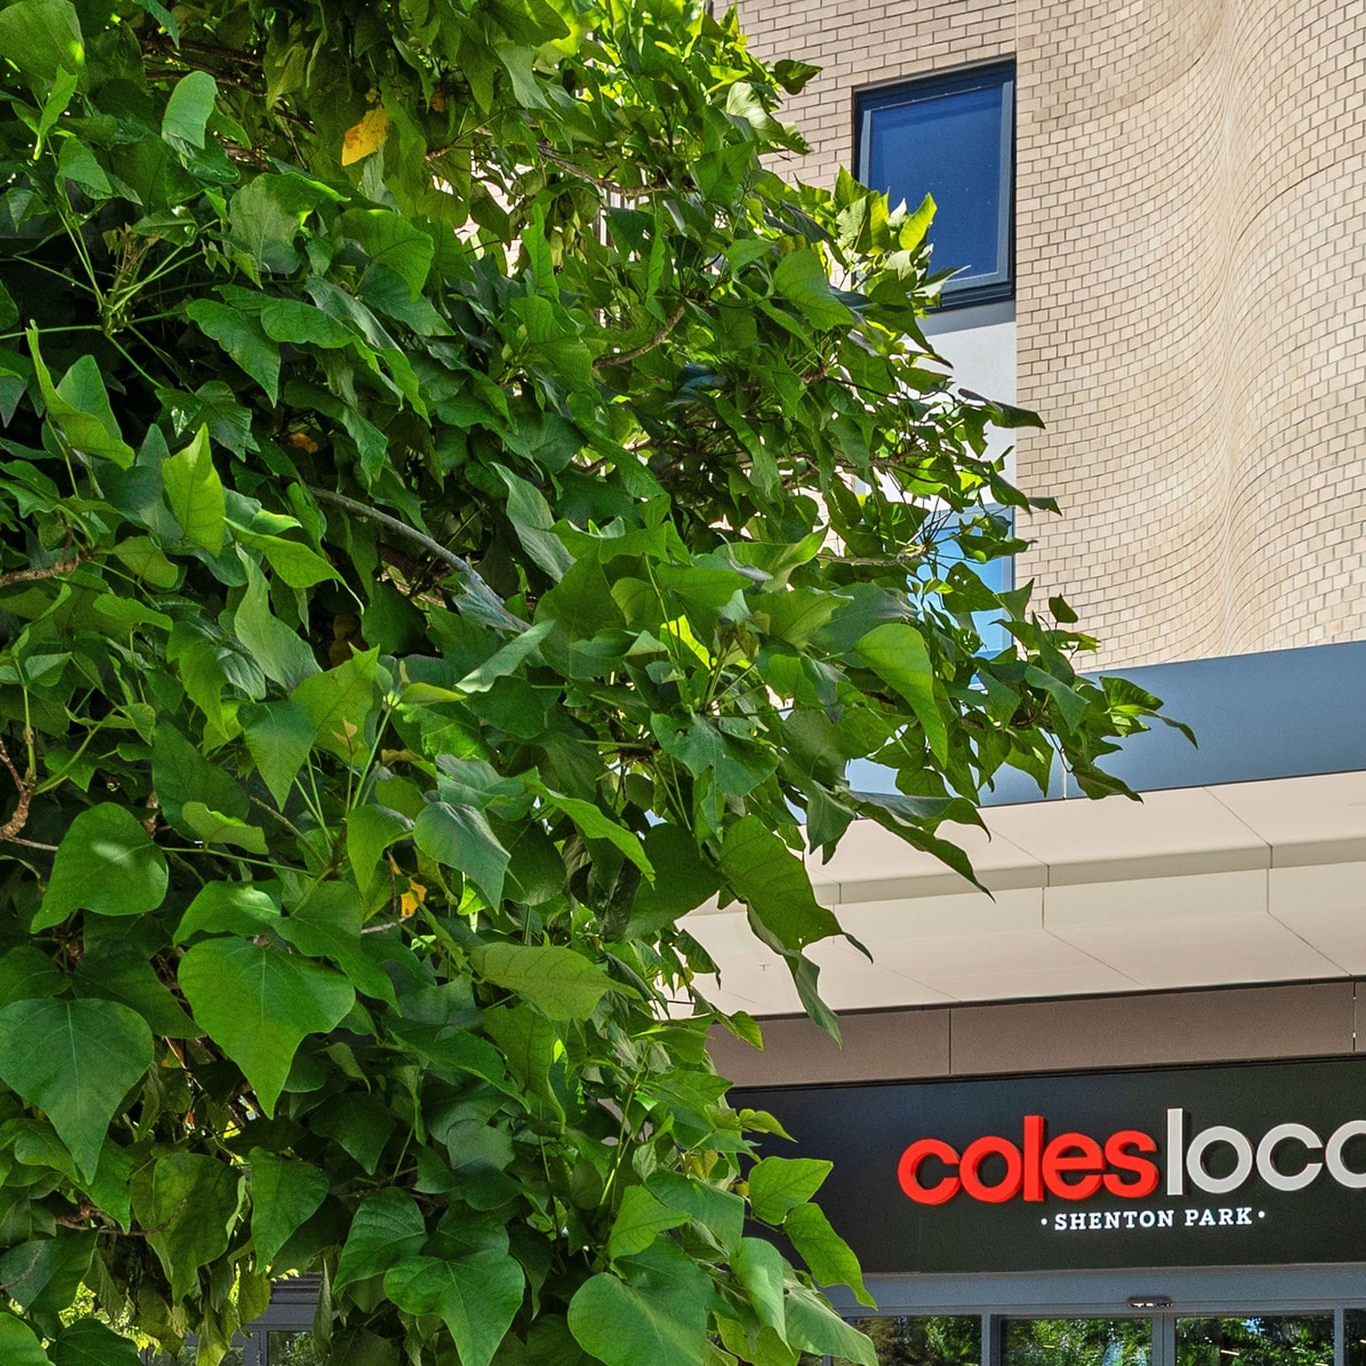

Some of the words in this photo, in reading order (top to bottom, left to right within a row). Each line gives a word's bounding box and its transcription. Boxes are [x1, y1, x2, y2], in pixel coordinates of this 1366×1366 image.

[897, 1115, 1160, 1206] coles
[1054, 1210, 1174, 1231] SHENTON
[1184, 1207, 1253, 1226] PARK
